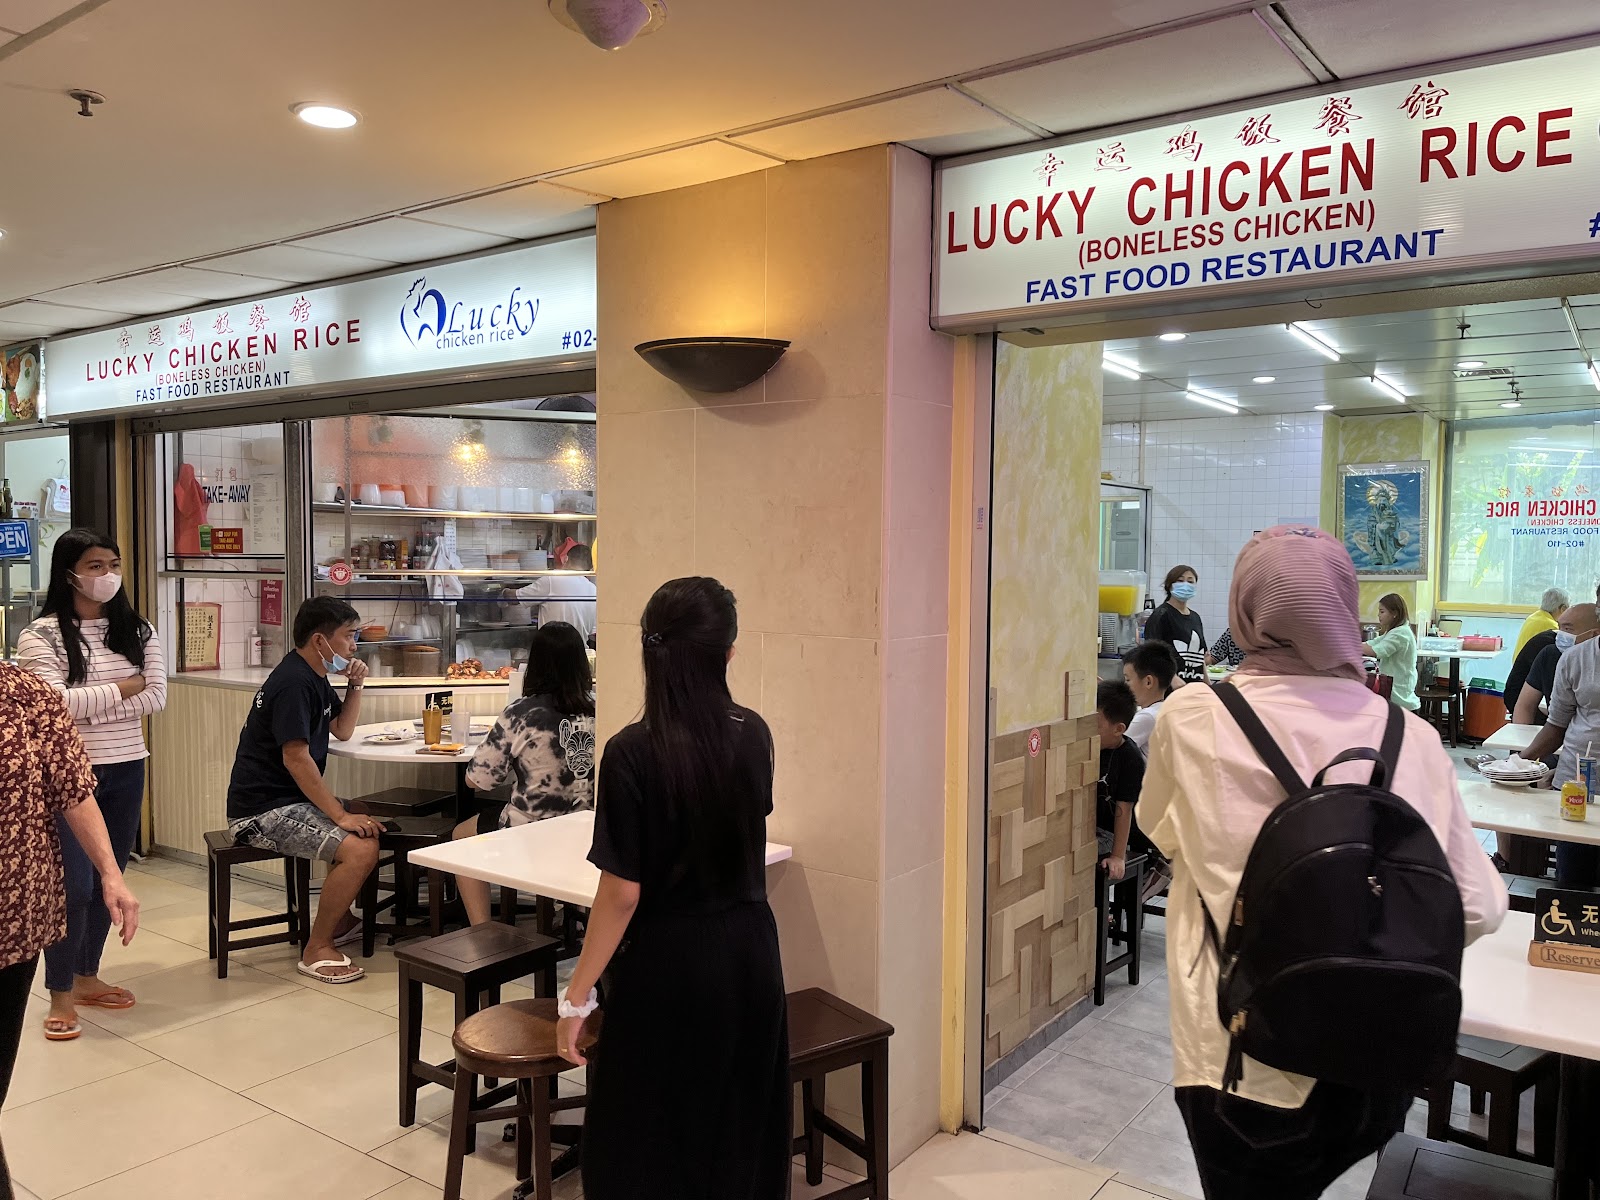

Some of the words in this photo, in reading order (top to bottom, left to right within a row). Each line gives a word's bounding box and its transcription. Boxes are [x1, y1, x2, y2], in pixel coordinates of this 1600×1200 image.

[1032, 80, 1449, 187] 幸运鸡饭餐馆
[947, 186, 1096, 254] LUCKY
[1127, 138, 1375, 226] CHICKEN
[1420, 107, 1573, 183] RICE
[1078, 221, 1225, 269] (BONELESS
[1234, 199, 1376, 242] CHICKEN)
[1026, 273, 1096, 303] FAST
[1105, 261, 1190, 294] FOOD
[1201, 229, 1445, 283] RESTAURANT
[436, 331, 484, 350] chicken
[490, 327, 515, 343] rice
[446, 286, 540, 336] Lucky
[86, 352, 154, 382] LUCKY
[168, 333, 277, 369] CHICKEN
[294, 319, 361, 351] RICE
[155, 368, 211, 386] (BONELESS
[215, 358, 266, 380] CHICKEN)
[136, 387, 163, 403] FAST
[168, 382, 200, 399] FOOD
[205, 370, 291, 395] RESTAURANT
[202, 485, 252, 504] TAKE-AWAY
